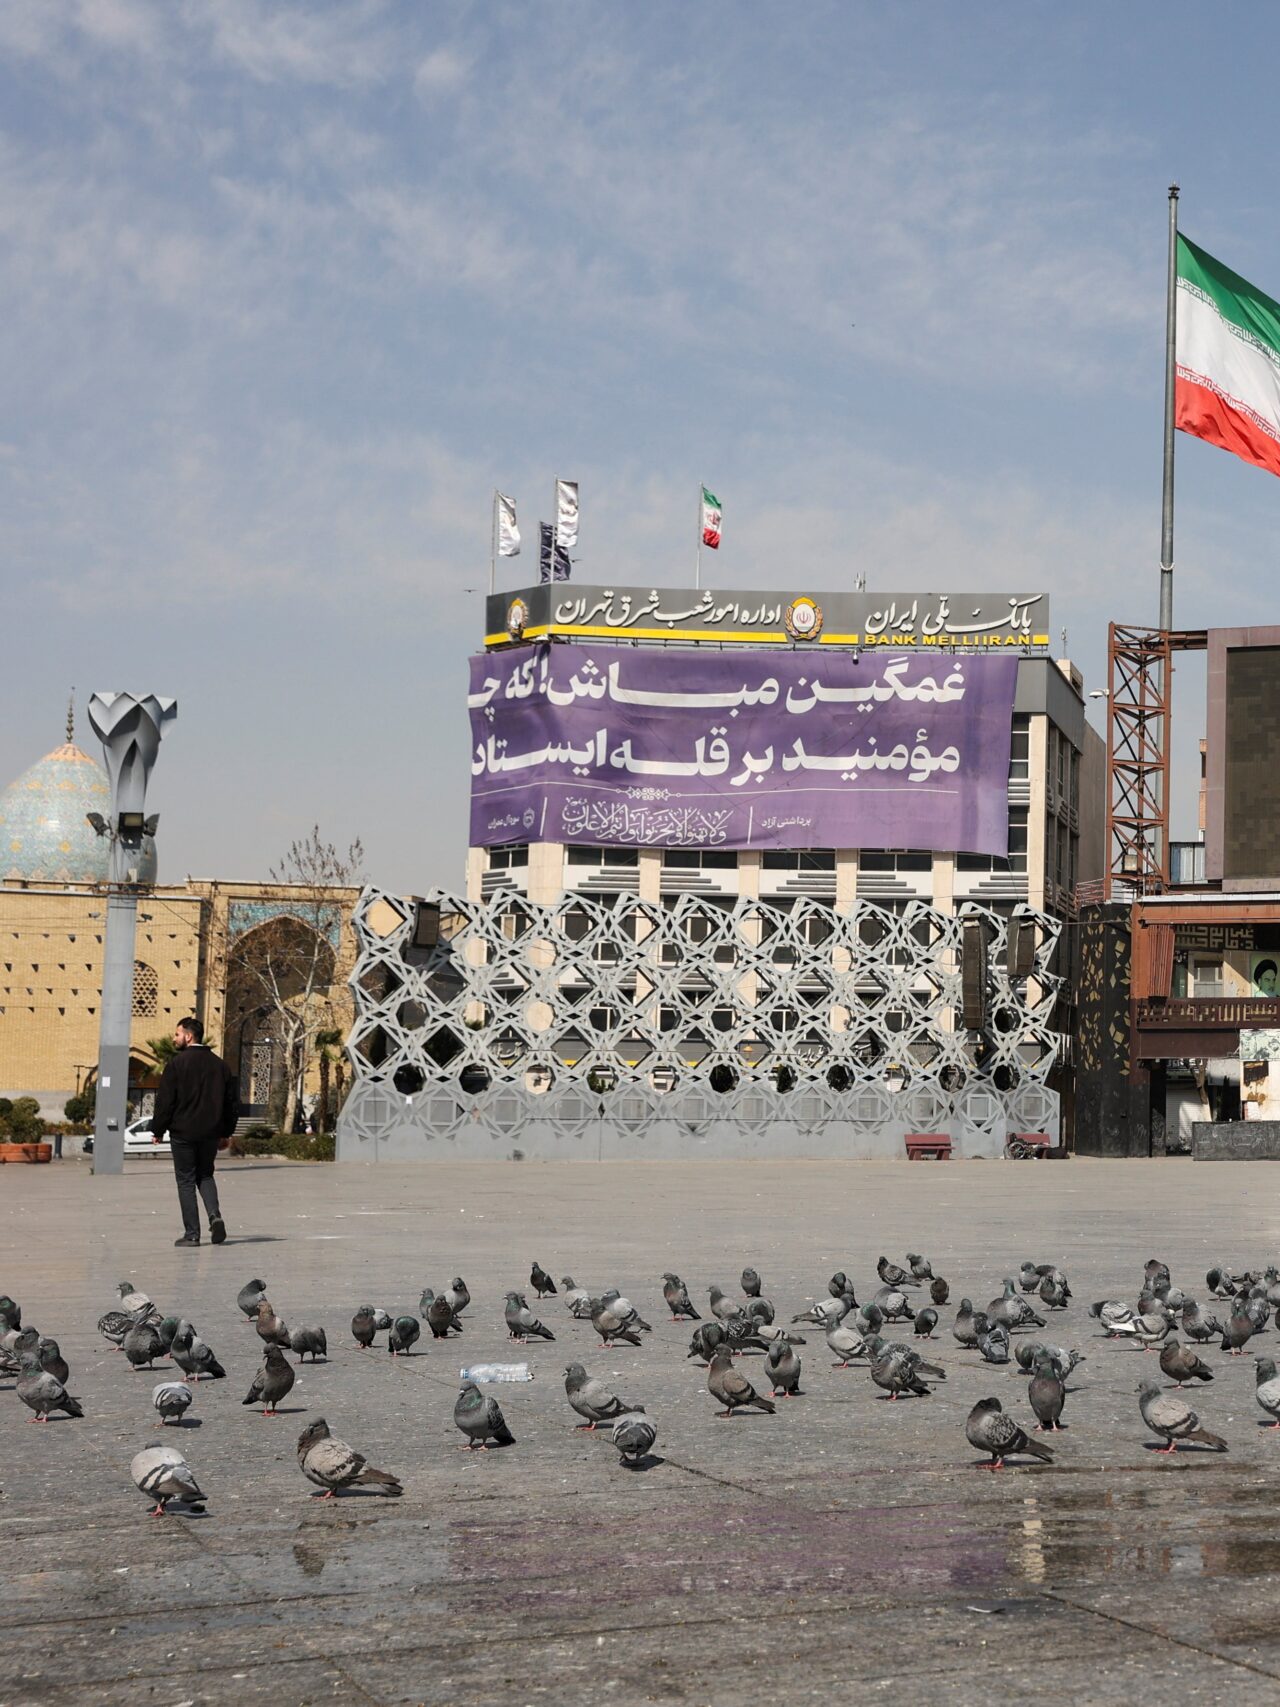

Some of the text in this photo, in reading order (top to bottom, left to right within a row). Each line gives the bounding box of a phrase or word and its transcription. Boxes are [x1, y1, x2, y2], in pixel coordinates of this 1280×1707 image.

[555, 589, 781, 628] اداره امور شعب شرق تهران
[864, 600, 918, 635] ایران
[945, 594, 1043, 635] بانک
[864, 634, 1030, 646] BANK MELLI IRAN
[785, 656, 966, 714] غمگین
[609, 726, 730, 777] قله
[730, 745, 774, 787] بر
